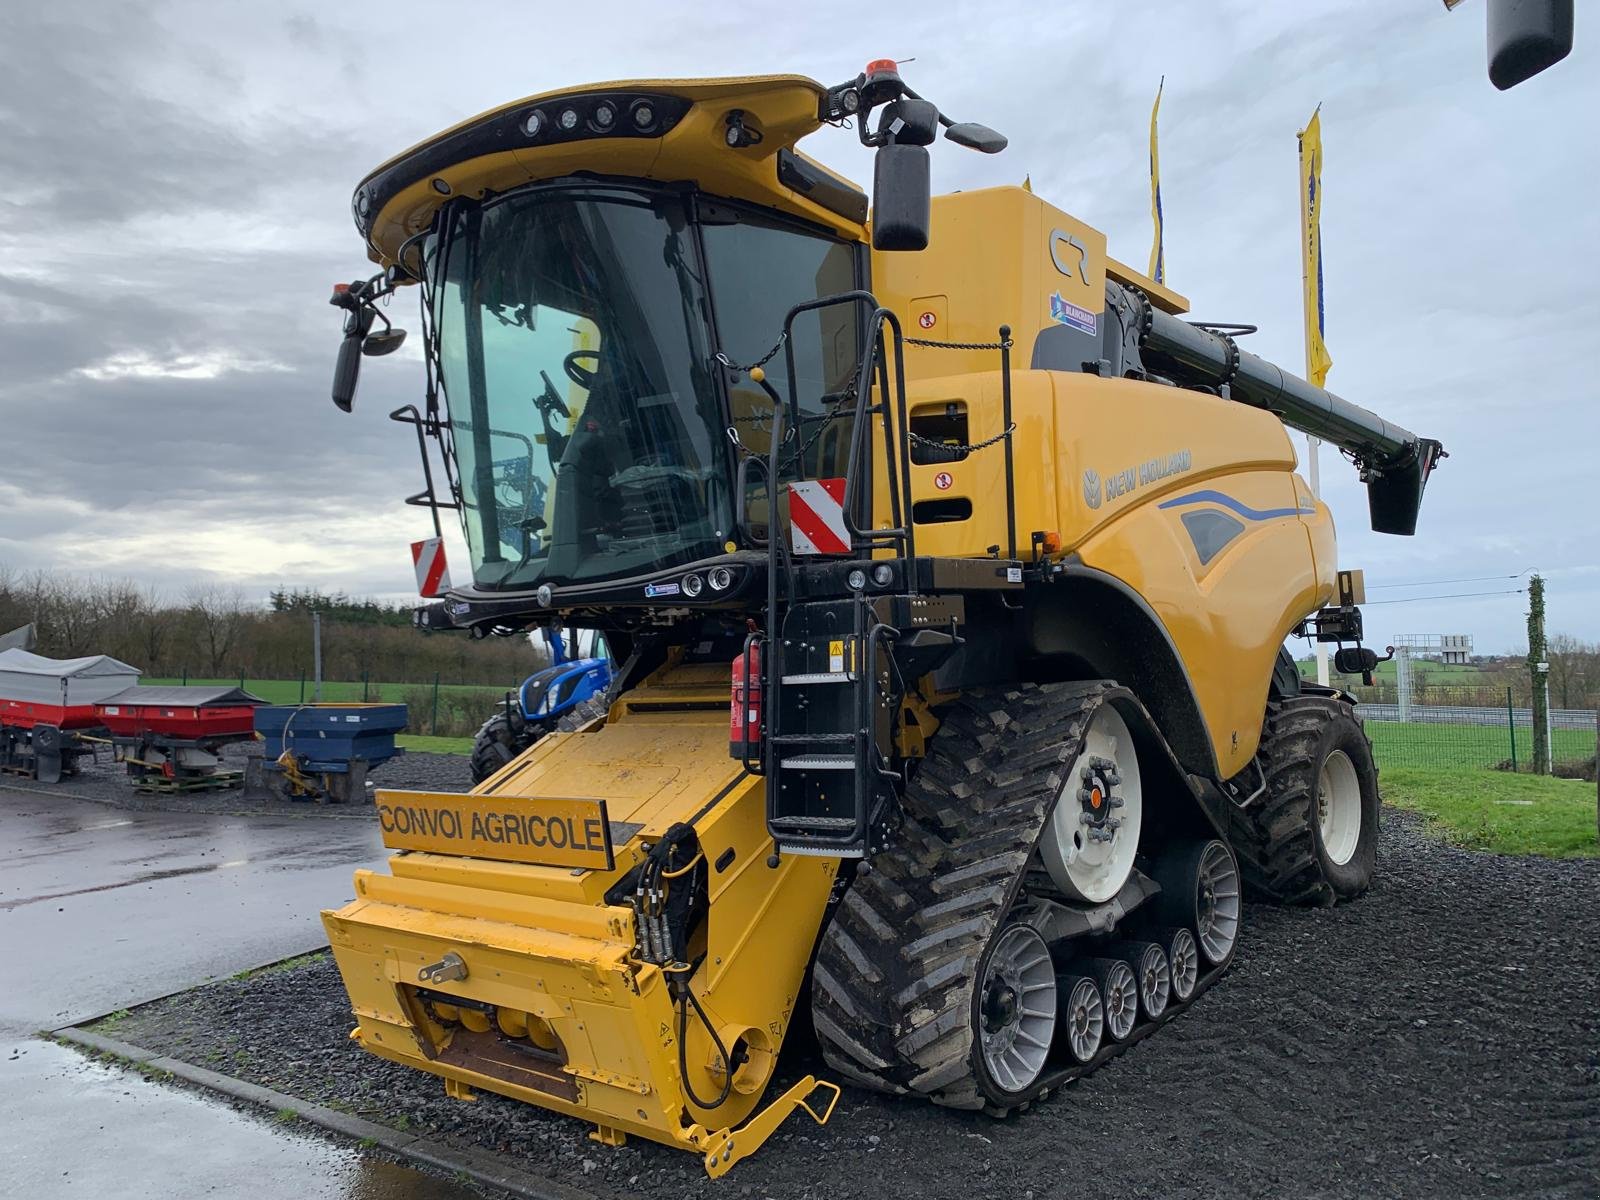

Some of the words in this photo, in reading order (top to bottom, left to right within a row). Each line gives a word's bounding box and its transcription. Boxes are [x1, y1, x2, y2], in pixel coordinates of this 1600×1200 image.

[1105, 465, 1137, 502] NEW
[1139, 447, 1192, 487] HOLLAND
[379, 804, 463, 839] CONVOI
[471, 811, 605, 852] AGRICOLE
